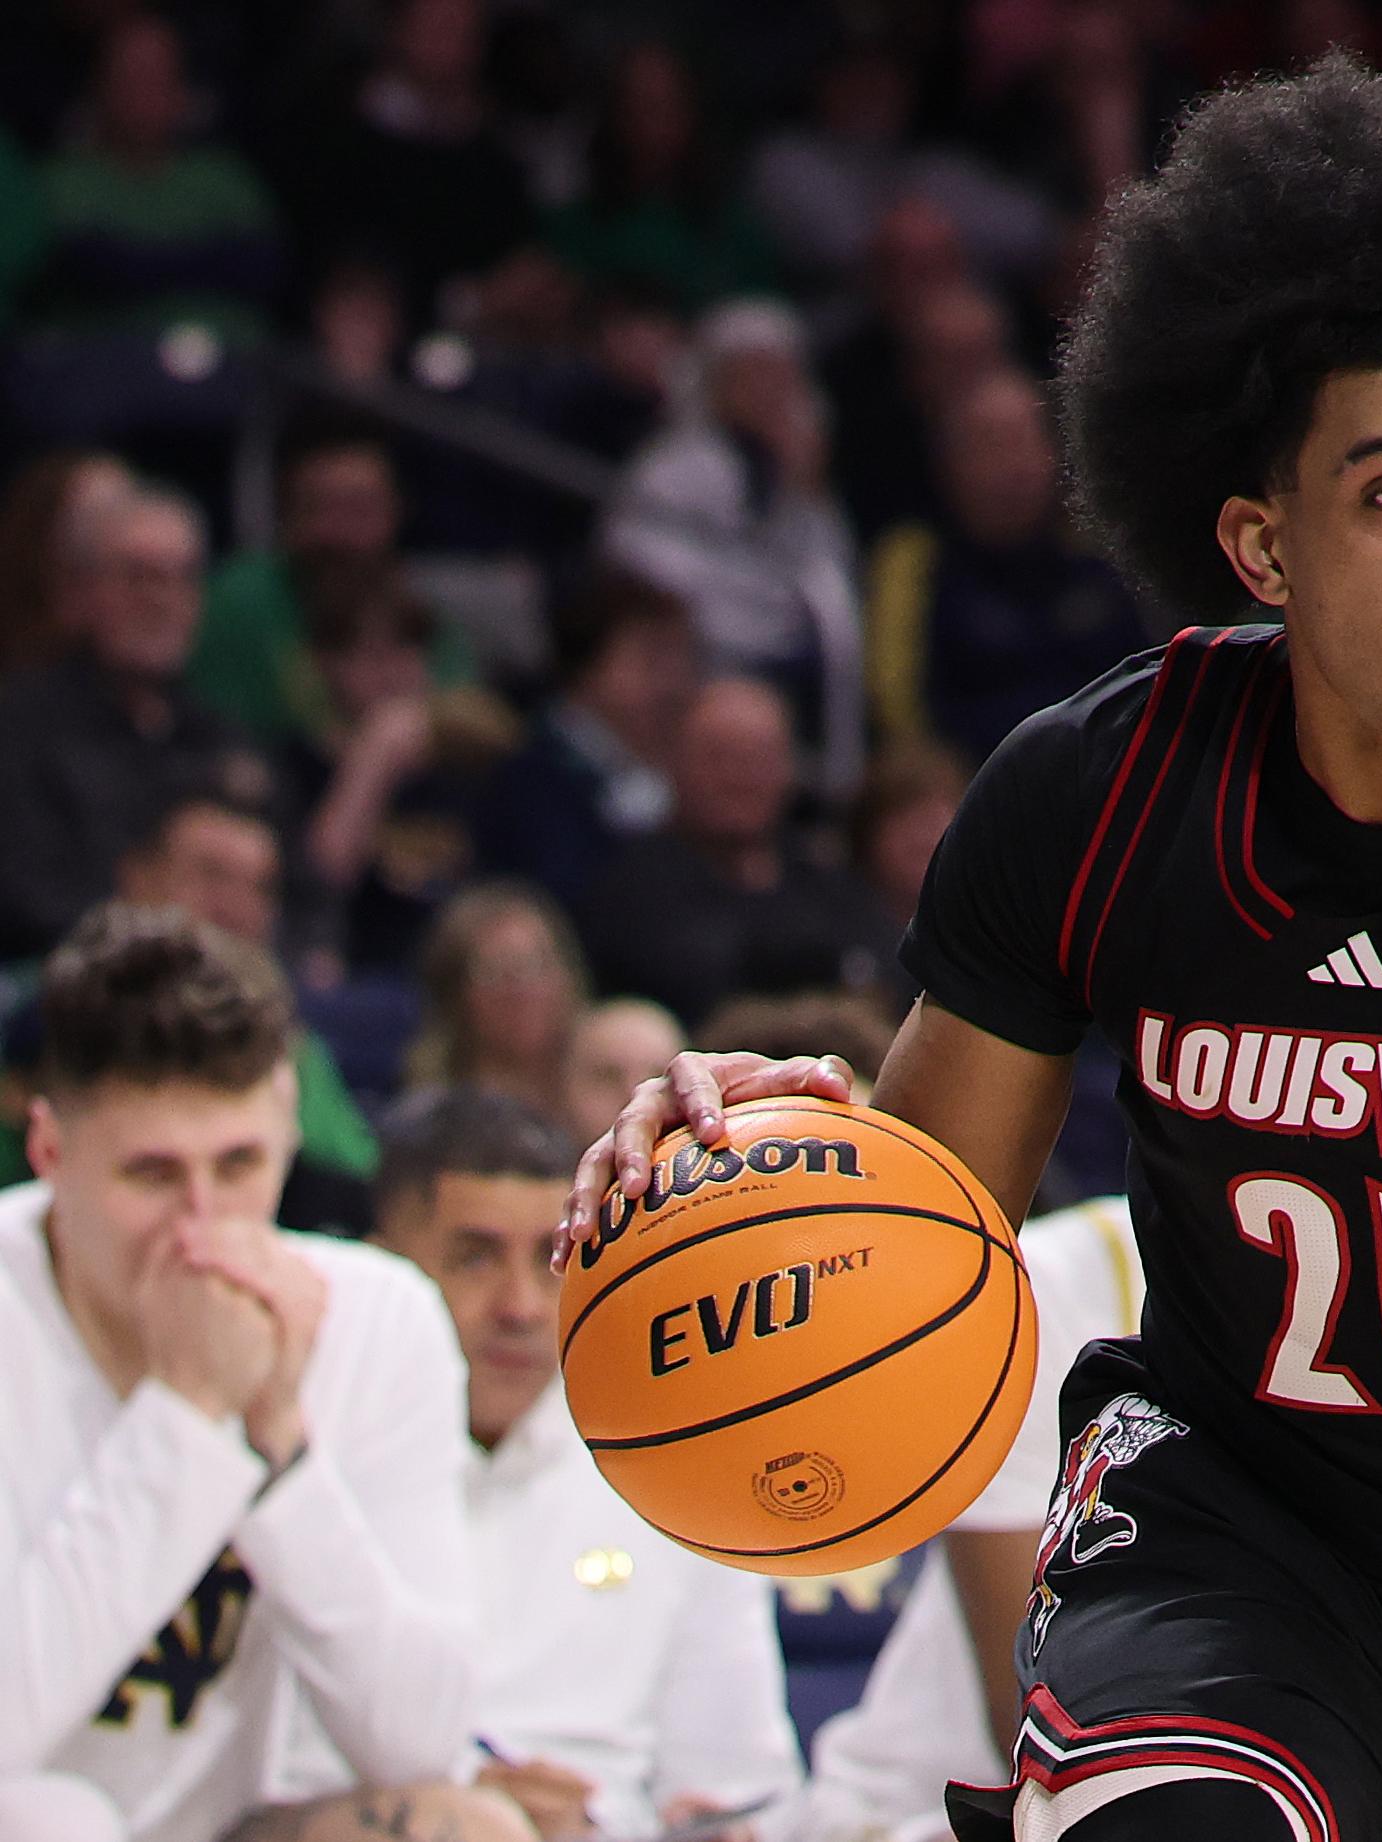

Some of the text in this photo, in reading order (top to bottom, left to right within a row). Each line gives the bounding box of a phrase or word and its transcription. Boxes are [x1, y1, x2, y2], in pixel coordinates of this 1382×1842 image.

[637, 1183, 778, 1236] INDOOR GAME BALL
[649, 1246, 875, 1376] EVO NXT
